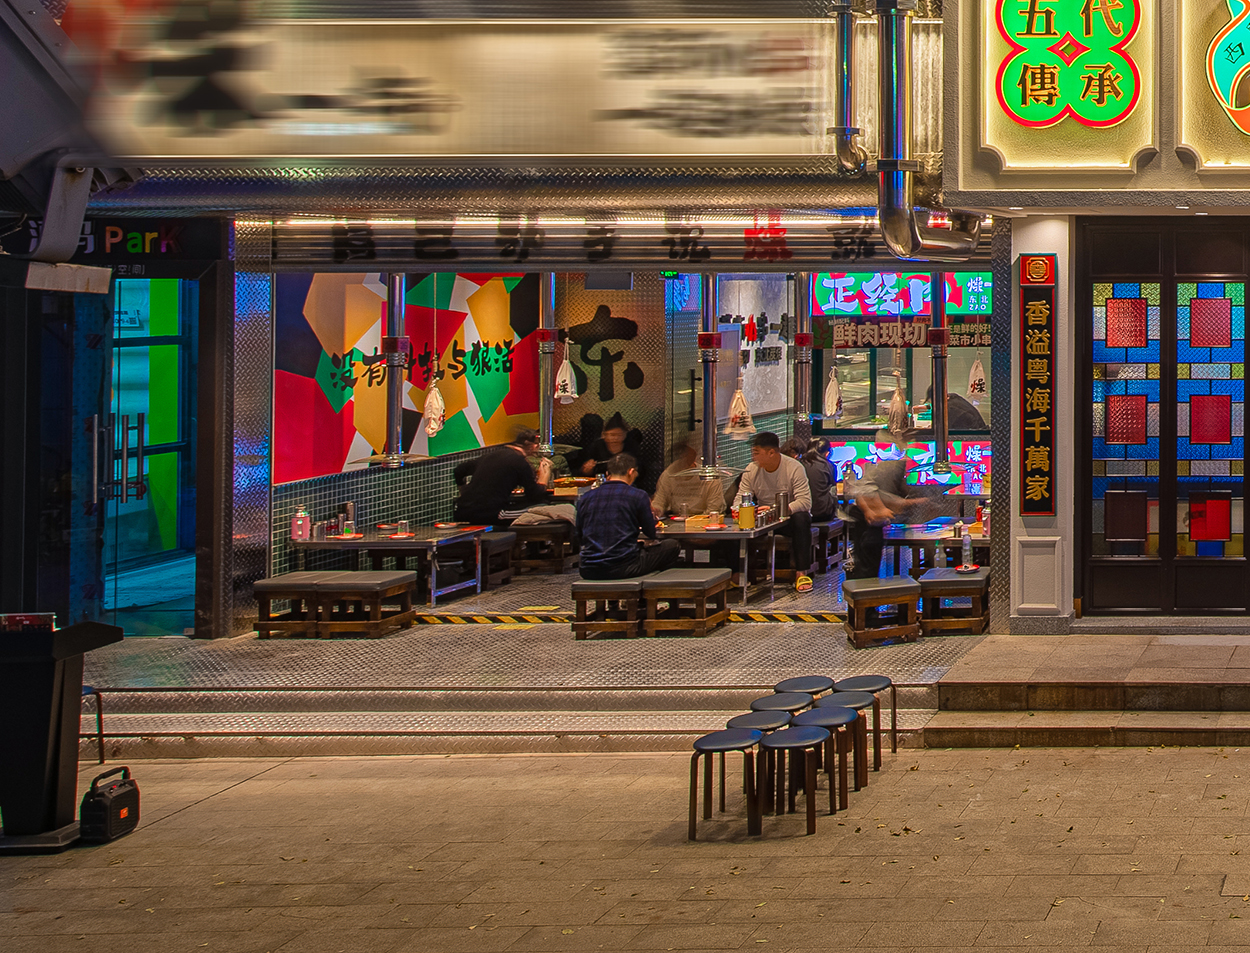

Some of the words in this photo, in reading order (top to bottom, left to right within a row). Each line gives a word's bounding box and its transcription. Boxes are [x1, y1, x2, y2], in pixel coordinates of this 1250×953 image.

[1016, 63, 1124, 108] 傳承
[833, 321, 927, 347] 鲜肉现切
